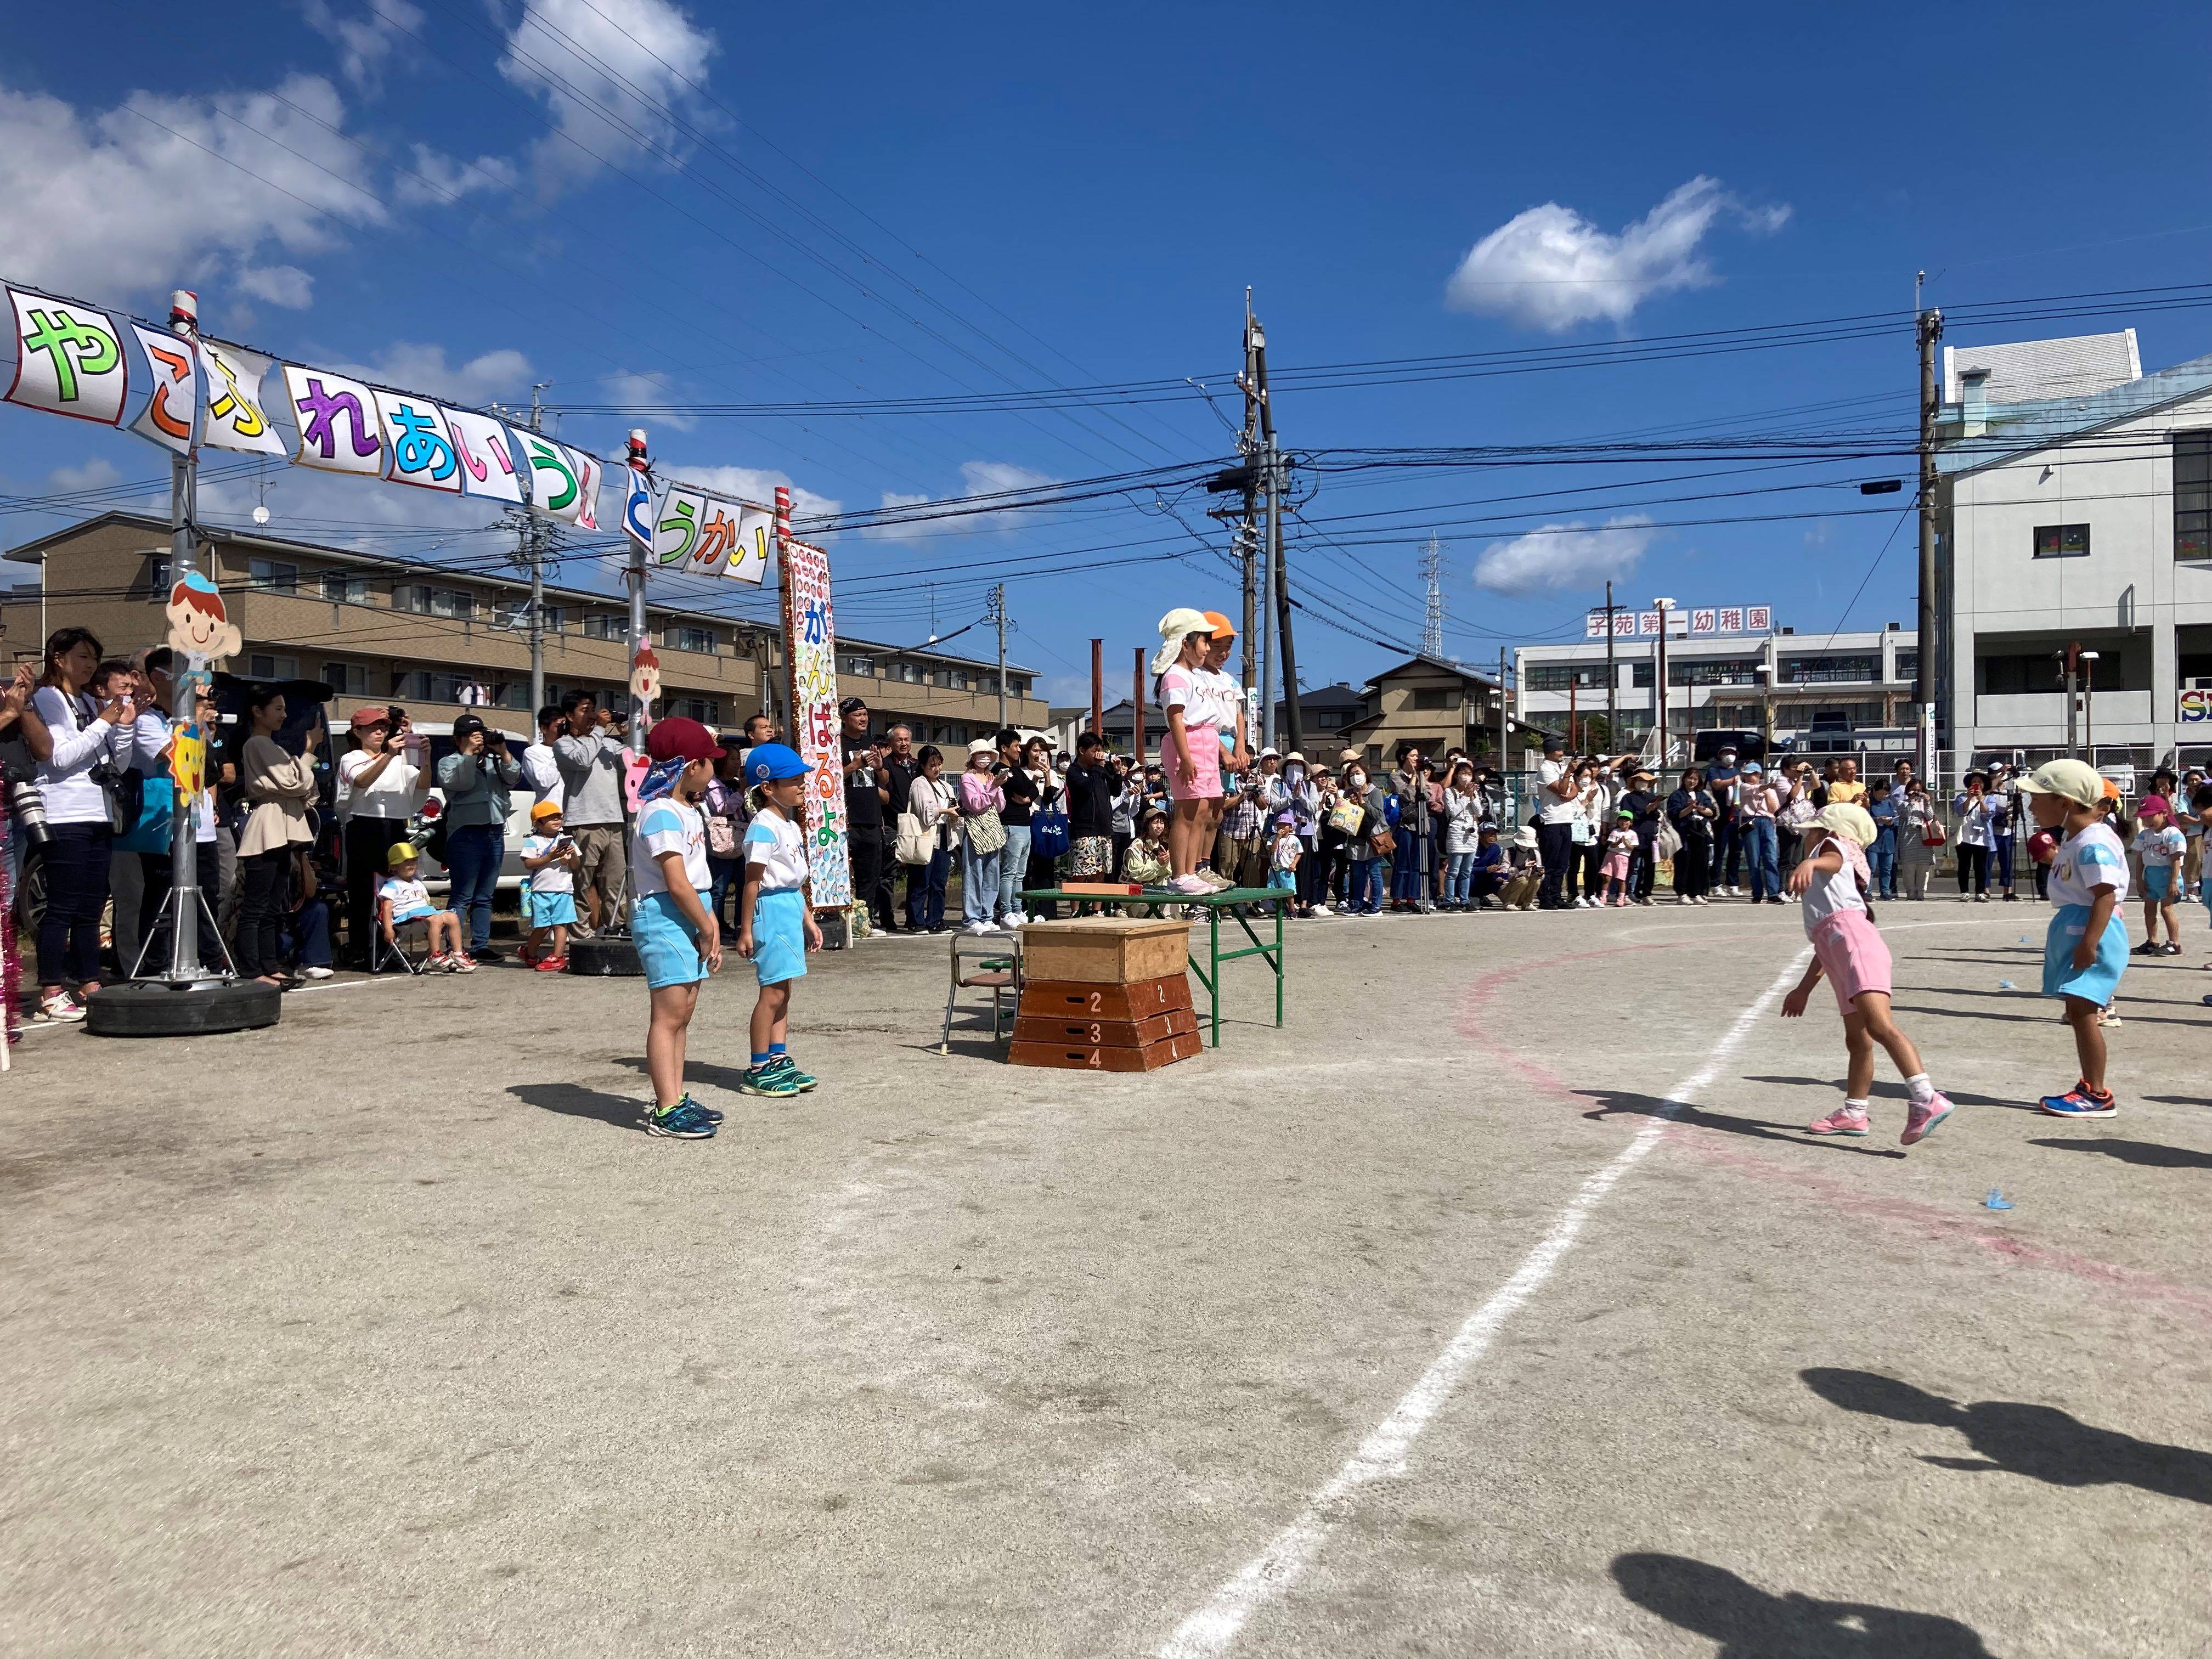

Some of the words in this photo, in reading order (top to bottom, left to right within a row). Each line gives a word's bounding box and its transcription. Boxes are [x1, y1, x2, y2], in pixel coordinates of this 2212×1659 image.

[2181, 691, 2212, 722] S
[805, 601, 838, 847] がんばるよ
[1090, 992, 1102, 1013] 2
[1158, 984, 1166, 1003] 2
[1090, 1023, 1101, 1043] 3
[1163, 1014, 1172, 1035] 3
[1089, 1048, 1102, 1069] 4
